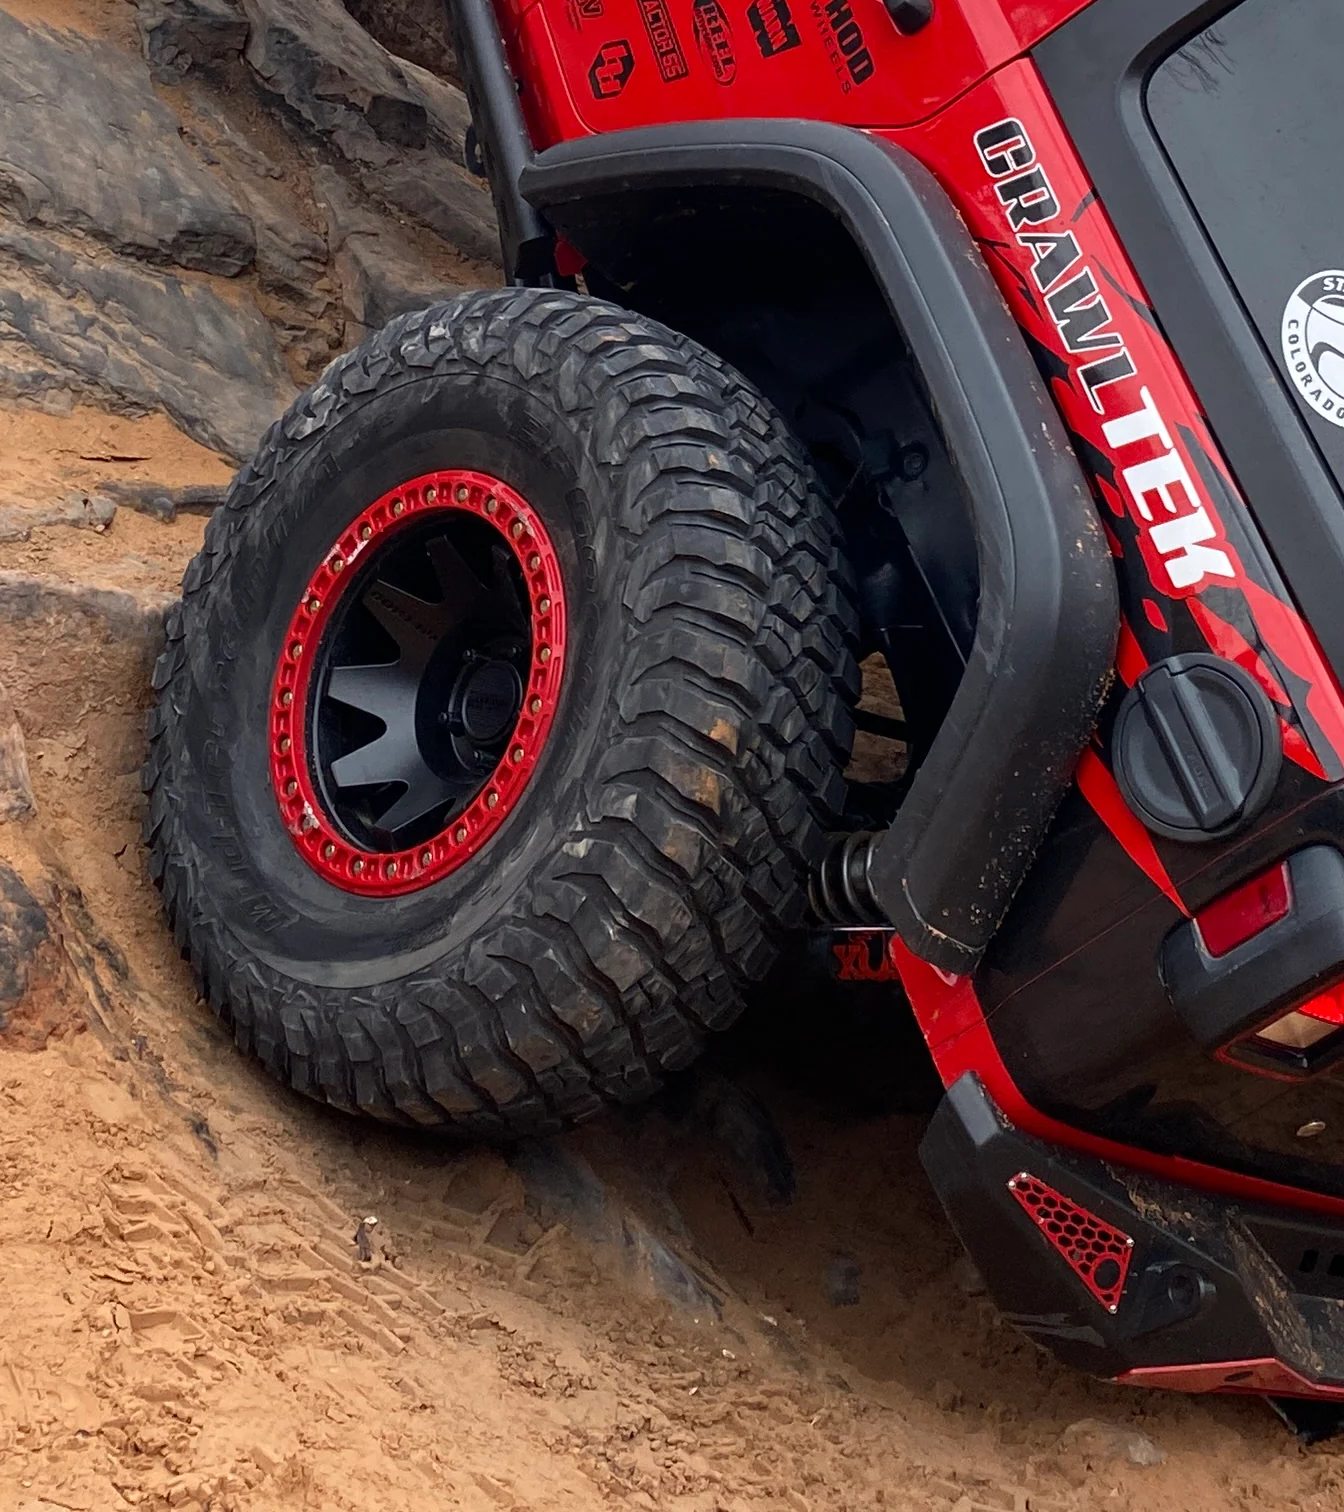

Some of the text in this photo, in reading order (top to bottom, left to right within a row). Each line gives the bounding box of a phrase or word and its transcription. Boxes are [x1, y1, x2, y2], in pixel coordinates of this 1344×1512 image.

[662, 52, 686, 79] 55
[703, 1, 736, 72] REEL
[809, 0, 853, 95] WHEELS
[973, 115, 1237, 590] CRAWLTEK
